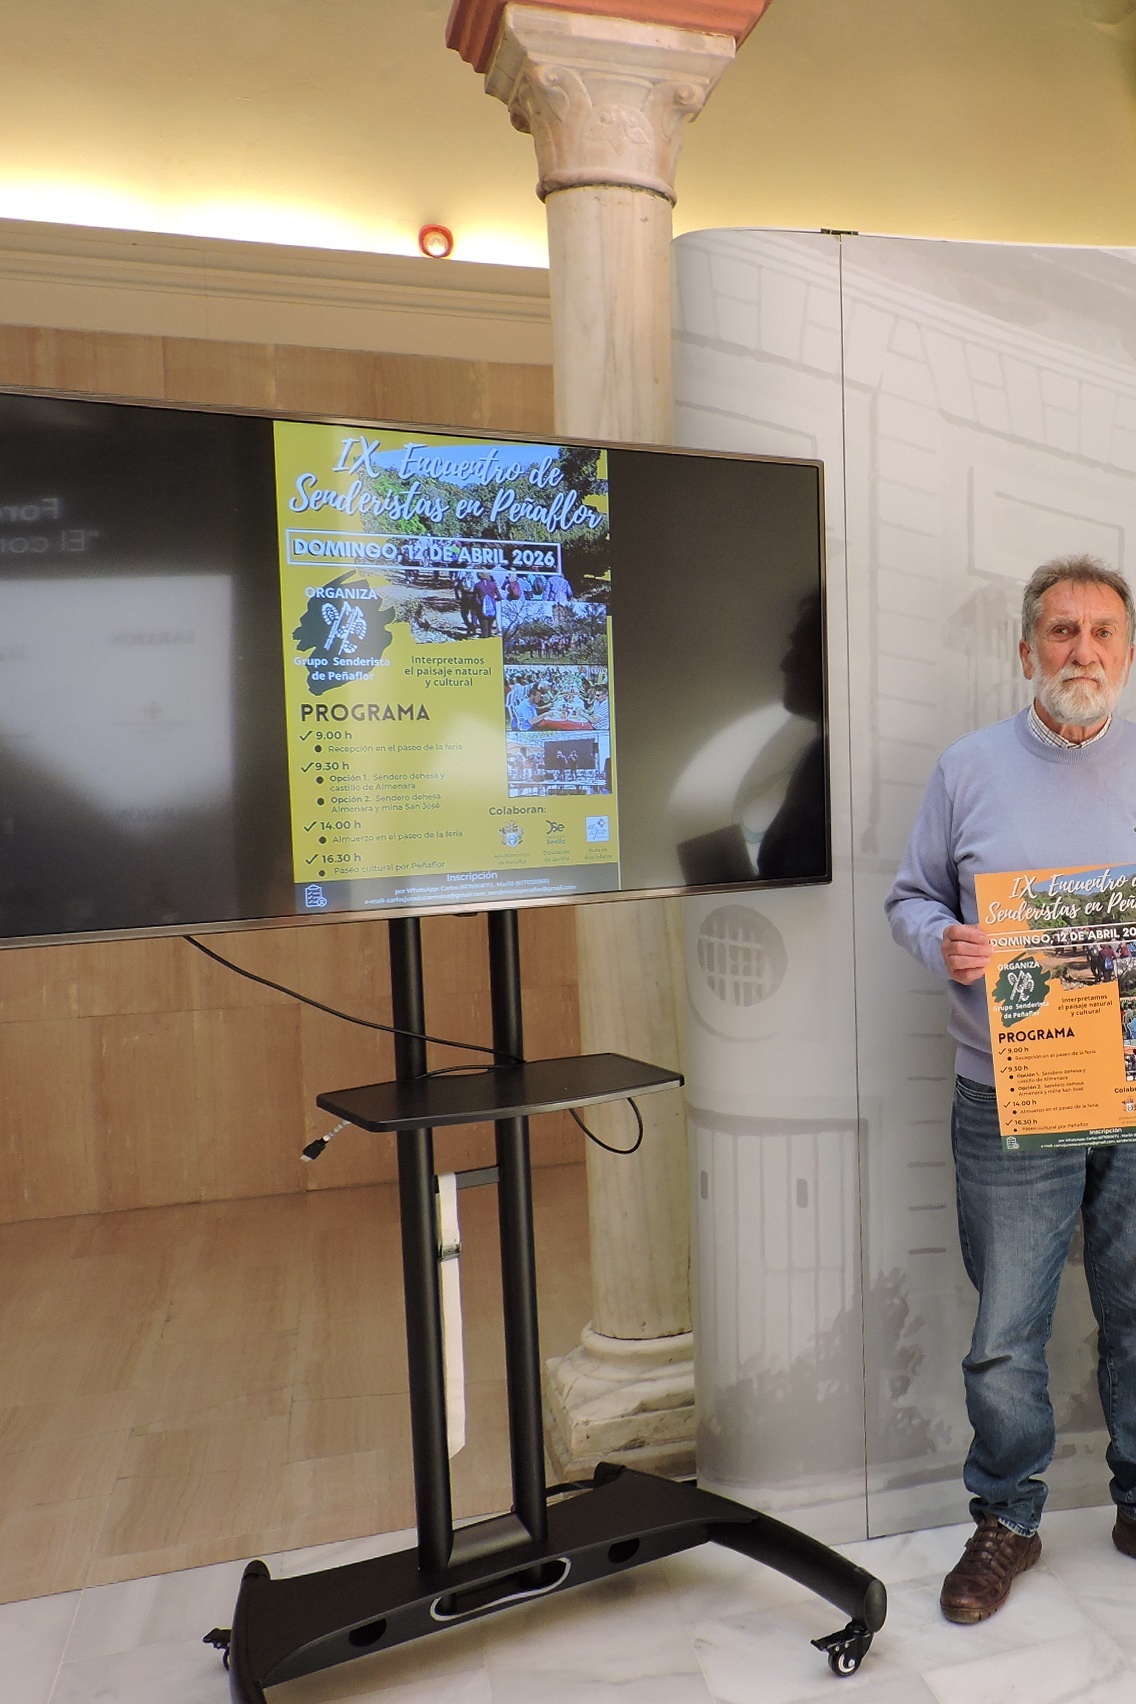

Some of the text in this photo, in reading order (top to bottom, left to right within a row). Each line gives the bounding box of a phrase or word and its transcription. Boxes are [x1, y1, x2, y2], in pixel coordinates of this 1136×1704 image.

[332, 436, 564, 488] IX Encuentro de
[289, 473, 603, 533] Senderistas en Peñaflor
[293, 538, 555, 567] DOMINGO, 12 DE ABRIL 2026
[305, 587, 378, 600] ORGANIZA
[294, 657, 391, 668] Grupo Senderista
[412, 656, 485, 666] Interpretamos
[312, 671, 374, 681] de Peñaflor
[405, 667, 492, 678] el paisaje natural
[425, 678, 473, 688] y cultural
[301, 703, 430, 722] PROGRAMA
[316, 731, 352, 740] 9.00 h
[328, 745, 374, 754] Recepción
[397, 745, 422, 753] paseo
[315, 762, 349, 771] 9.30 h
[330, 774, 361, 783] Opción
[373, 773, 407, 781] Sendero
[410, 772, 439, 780] dehesa
[330, 784, 361, 792] castillo
[375, 782, 416, 790] Almenara
[331, 796, 363, 804] Opción
[376, 794, 410, 802] Sendero
[412, 793, 441, 801] dehesa
[331, 805, 373, 813] Almenara
[422, 802, 440, 810] José
[489, 806, 547, 816] Colaboran:
[320, 821, 361, 830] 14.00 h
[332, 835, 374, 843] Almuerzo
[398, 833, 422, 841] paseo
[322, 853, 361, 863] 16.30 h
[362, 865, 394, 873] cultural
[396, 864, 409, 872] por
[411, 861, 445, 869] Peñaflor
[447, 872, 498, 882] Inscripción
[1009, 874, 1037, 899] IX
[1049, 869, 1128, 897] Encuentro
[985, 896, 1081, 925] Senderistas
[1085, 903, 1102, 915] en
[990, 934, 1054, 947] DOMINGO,
[1055, 931, 1066, 942] 12
[1070, 930, 1084, 941] DE
[1087, 928, 1119, 940] ABRIL
[997, 961, 1040, 971] ORGANIZA
[1061, 994, 1108, 1003] Interpretamos
[993, 1001, 1050, 1013] Grupo Senderista
[1065, 1003, 1088, 1011] paisaje
[1076, 1008, 1101, 1016] cultural
[998, 1027, 1075, 1044] PROGRAMA
